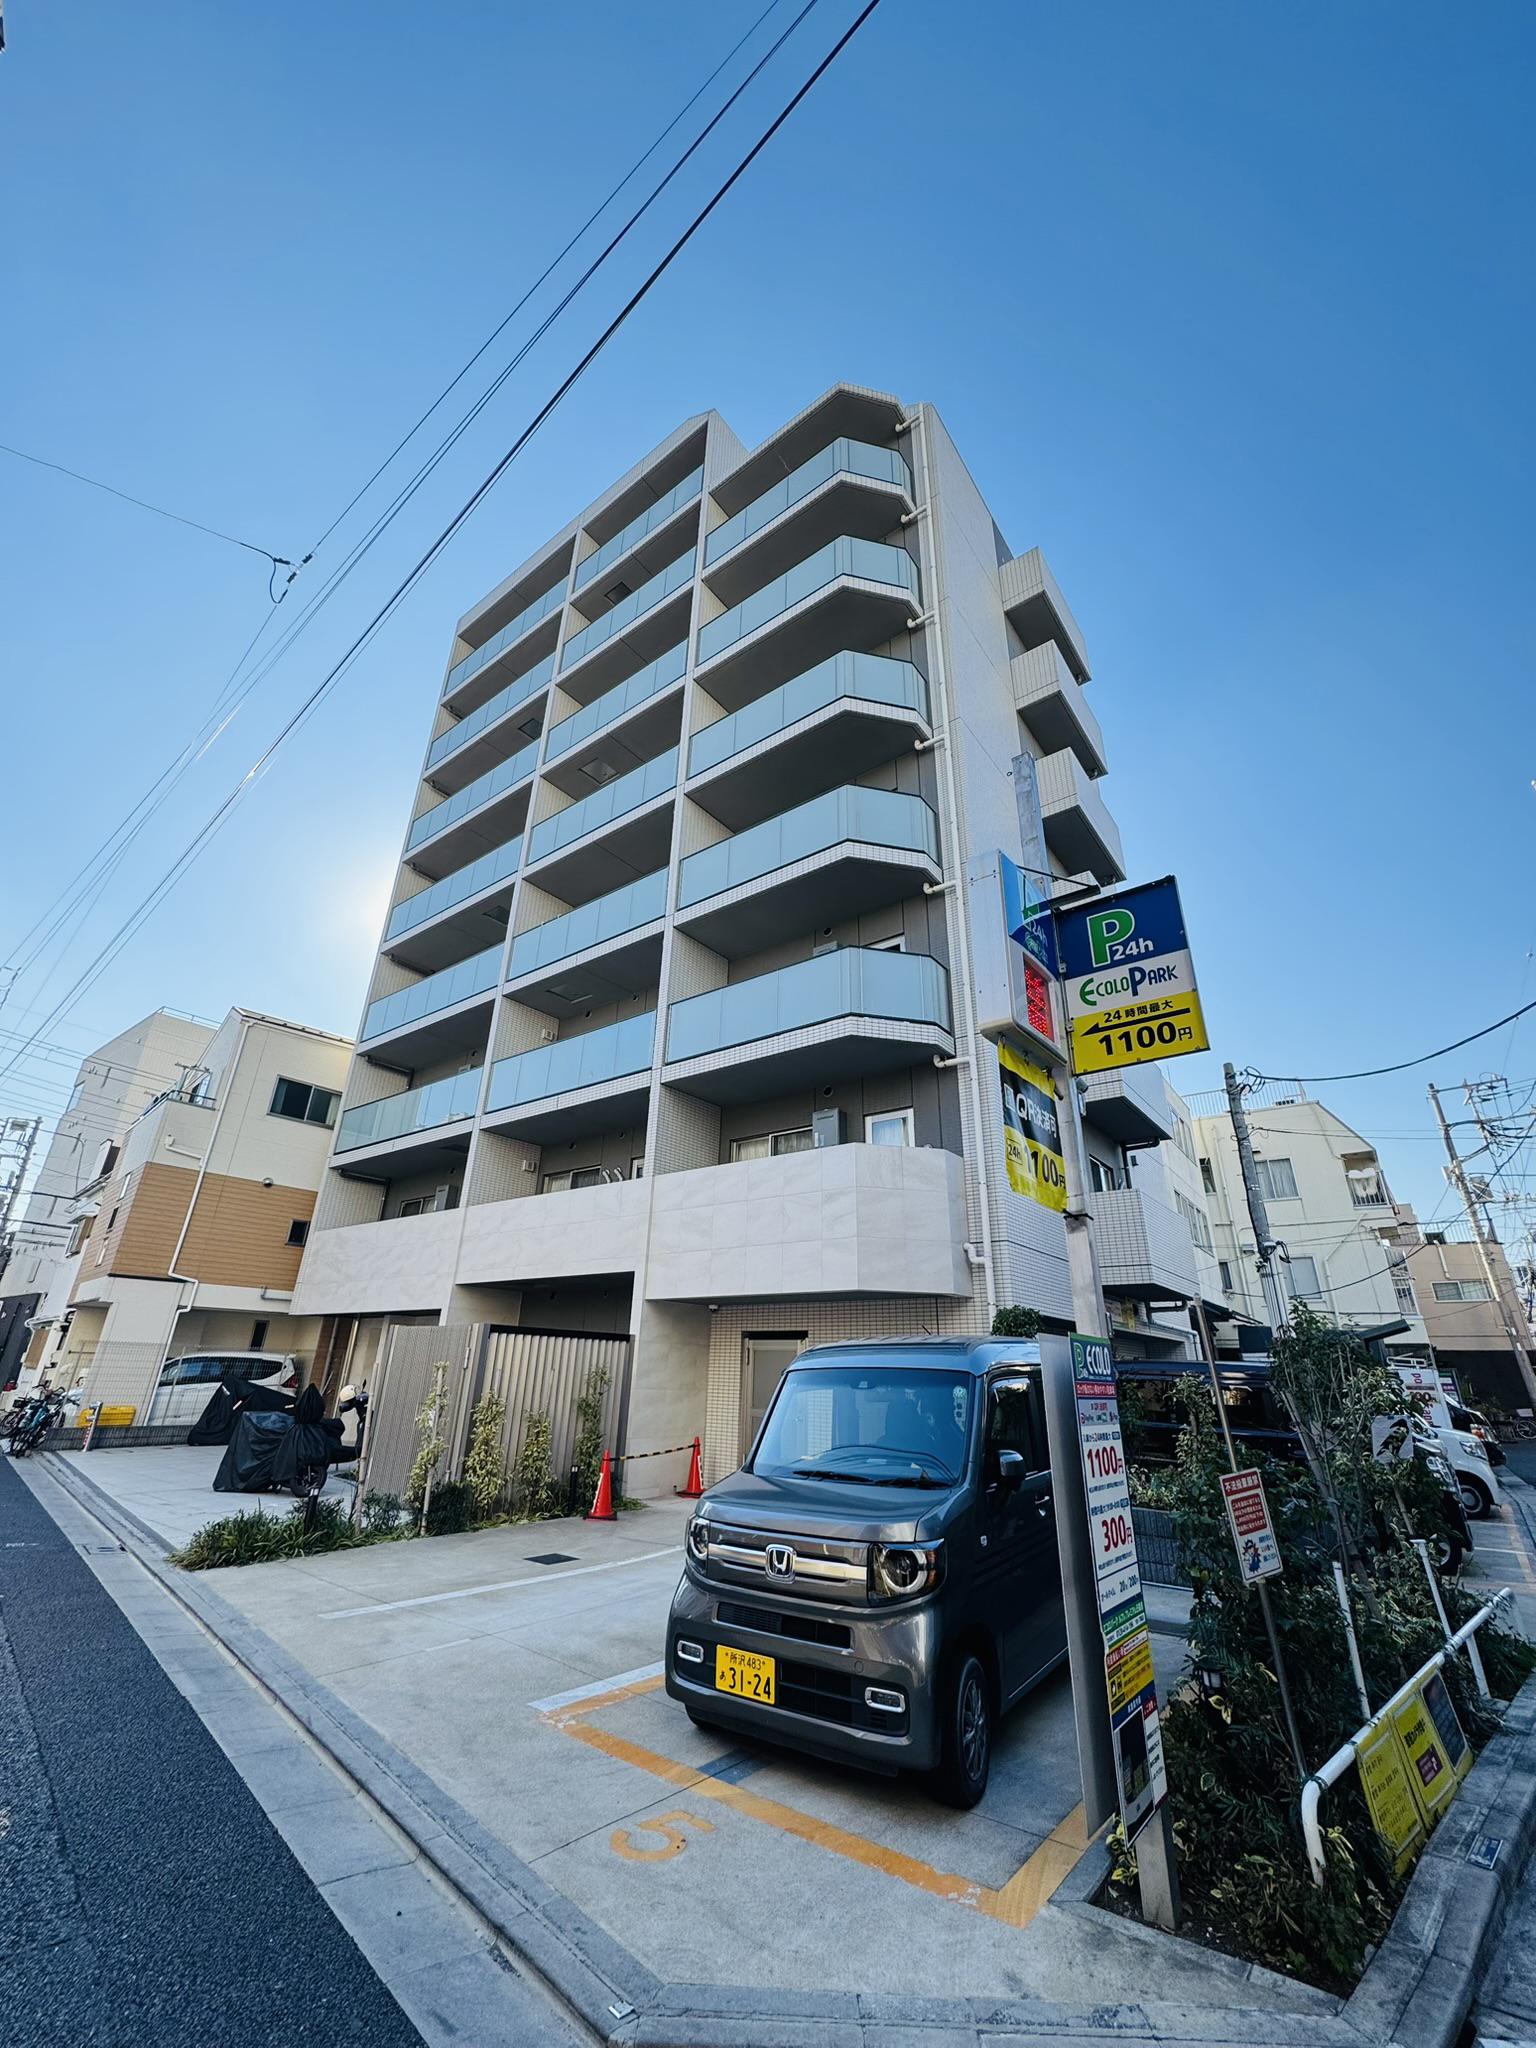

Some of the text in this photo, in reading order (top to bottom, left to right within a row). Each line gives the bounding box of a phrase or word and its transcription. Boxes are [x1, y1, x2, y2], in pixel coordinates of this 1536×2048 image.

[1087, 908, 1135, 967] P
[1112, 937, 1154, 961] 24h
[1098, 1021, 1192, 1056] 1100円
[1008, 1144, 1021, 1159] 24h
[1086, 1344, 1111, 1376] ECOLO
[608, 1809, 718, 1862] 5
